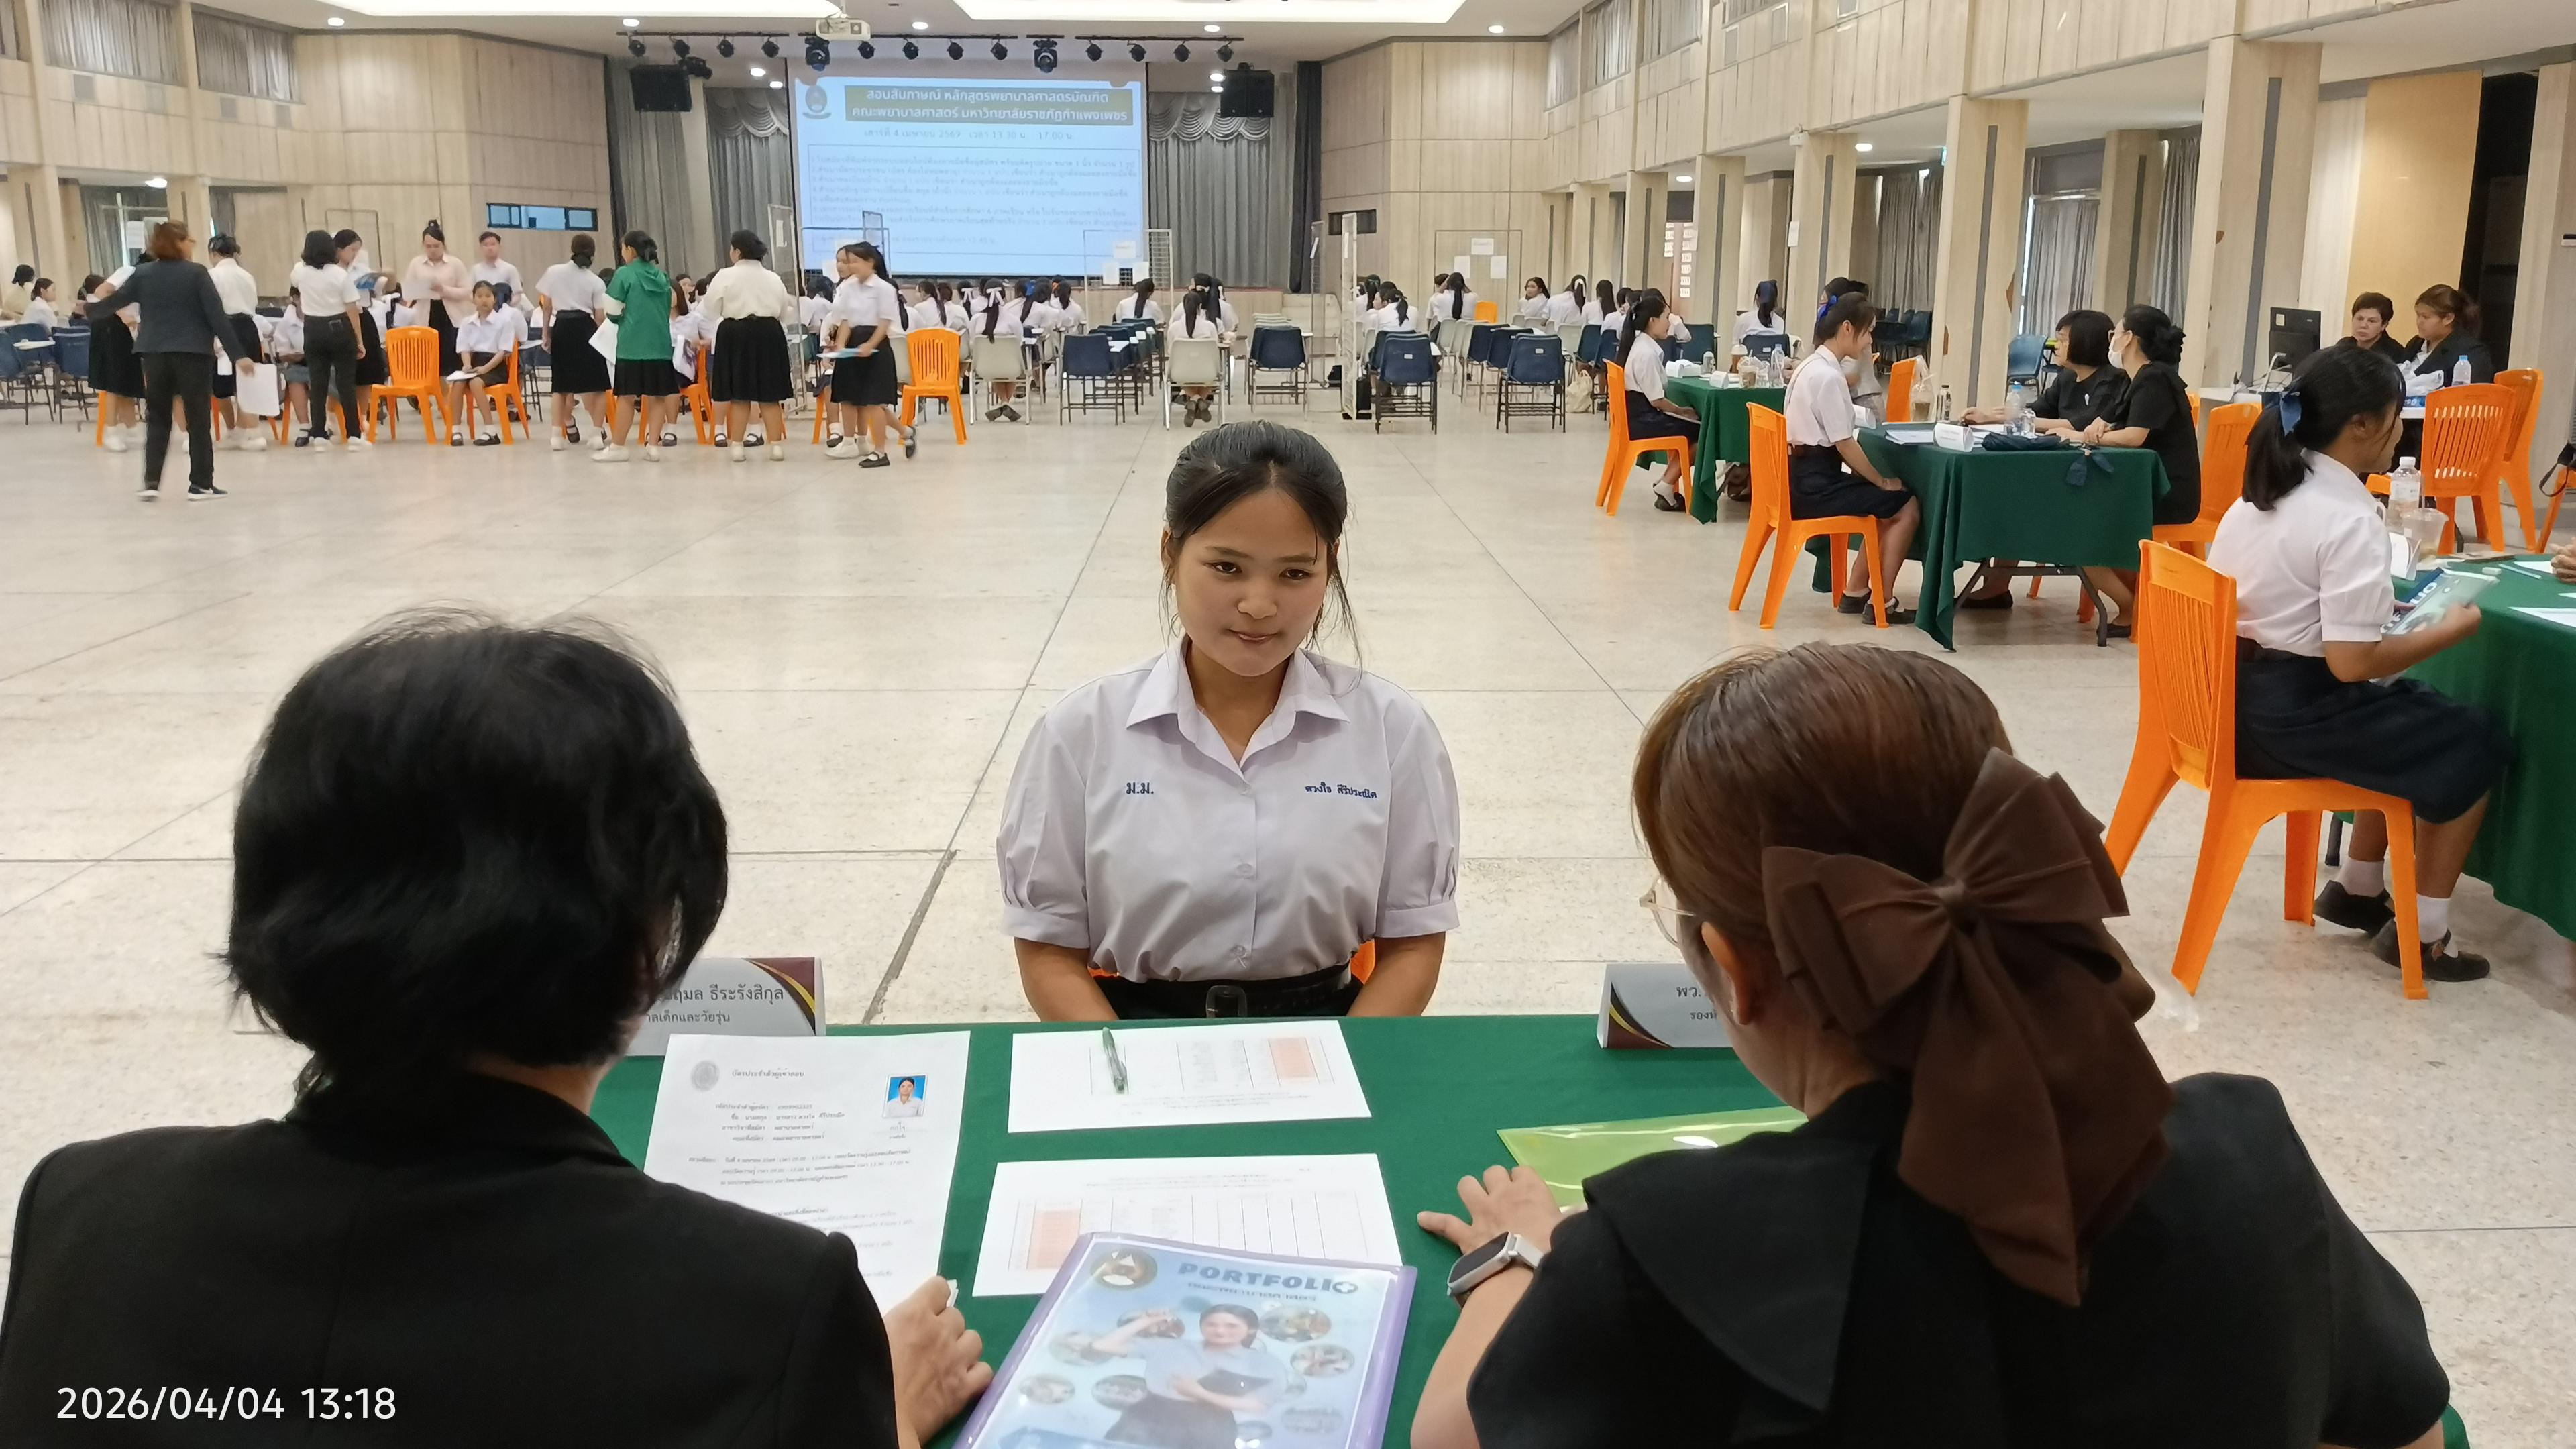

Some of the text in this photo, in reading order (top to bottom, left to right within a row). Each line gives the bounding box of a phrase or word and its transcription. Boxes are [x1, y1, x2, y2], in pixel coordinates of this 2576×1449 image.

[867, 89, 1109, 104] สอบสัมภาษณ์ หลักสูตรพยาบาลศาสตรบัณฑิต
[852, 107, 1128, 122] คณะพยาบาลศาสตร์ มหาวิทยาลัยราชภัฏกำแพงเพชร
[1126, 782, 1155, 795] ม.ม.
[710, 983, 784, 1005] ธีระรังสิกุล
[1676, 987, 1701, 998] พว.
[647, 1010, 731, 1025] าลเด็กและวัยรุ่น
[1177, 1261, 1358, 1295] PORTFOLIO
